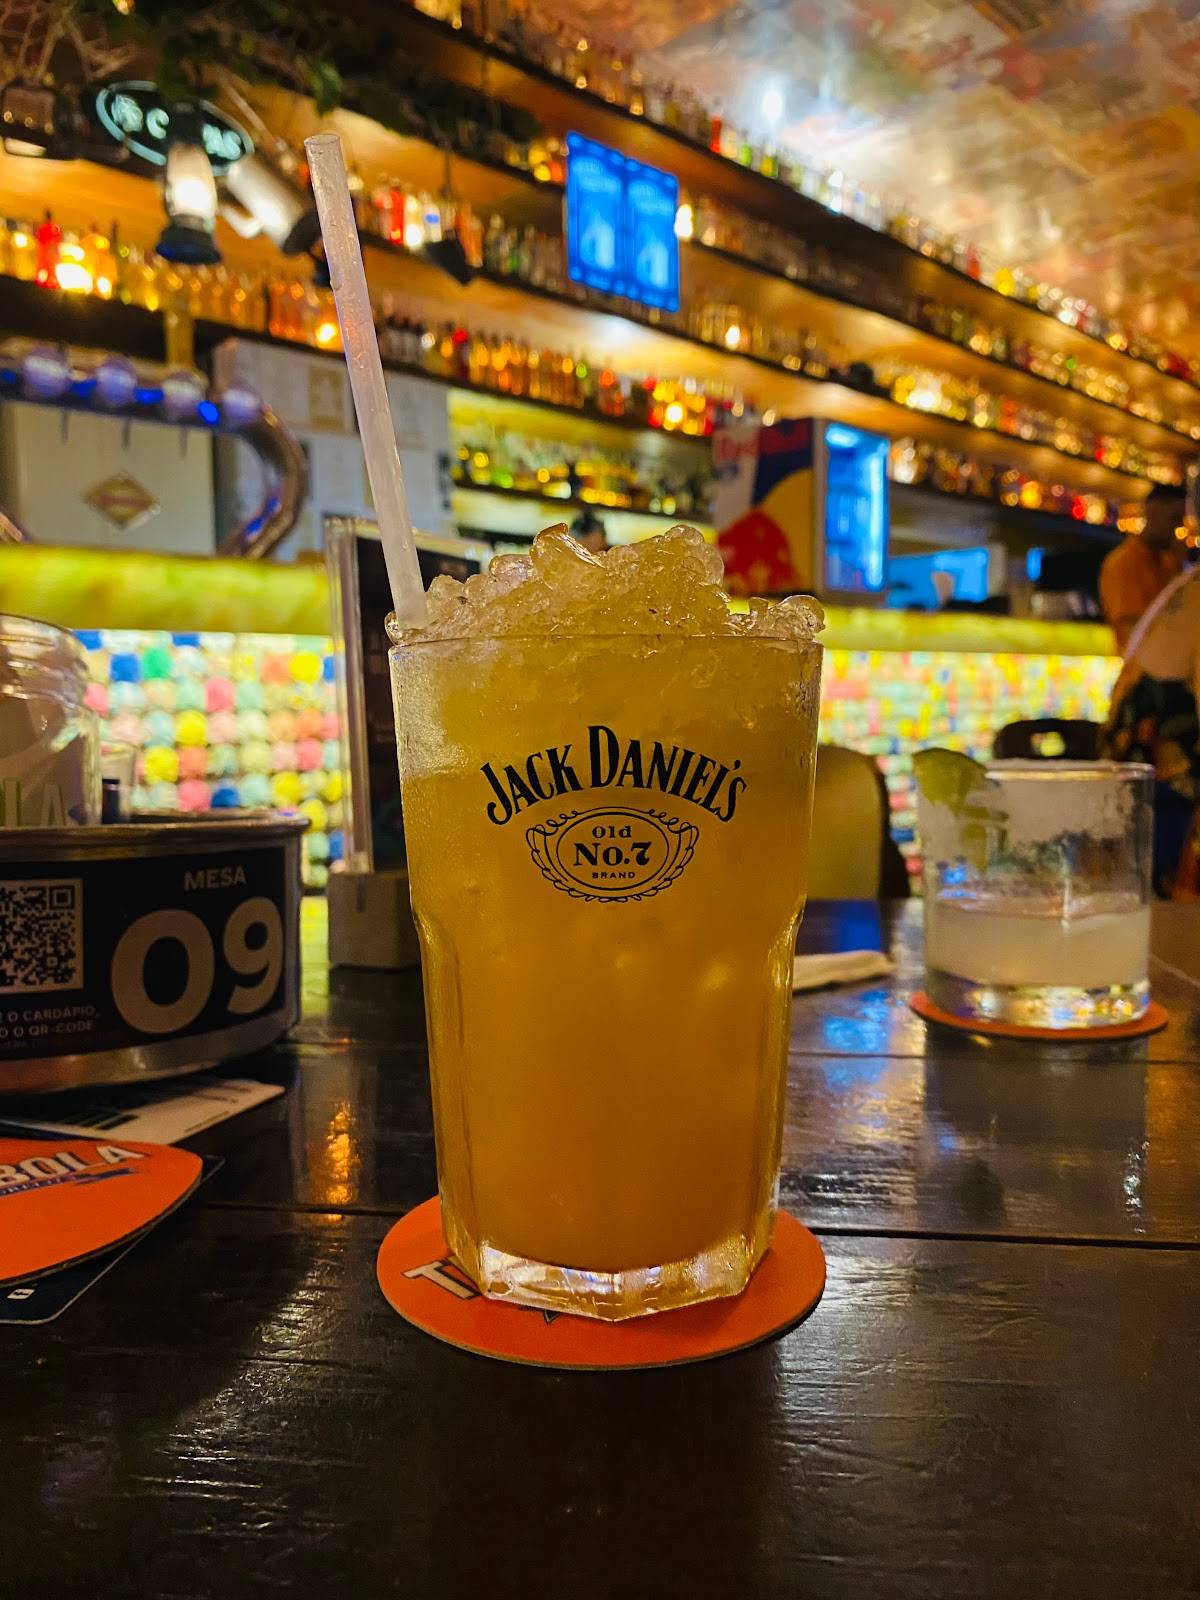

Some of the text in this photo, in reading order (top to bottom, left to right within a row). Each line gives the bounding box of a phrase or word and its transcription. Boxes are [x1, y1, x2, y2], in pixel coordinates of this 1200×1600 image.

[480, 725, 747, 825] JACK DANIEL'S
[591, 826, 632, 839] Old
[184, 866, 247, 891] MESA
[591, 871, 636, 880] BRAND
[110, 896, 284, 1034] 09
